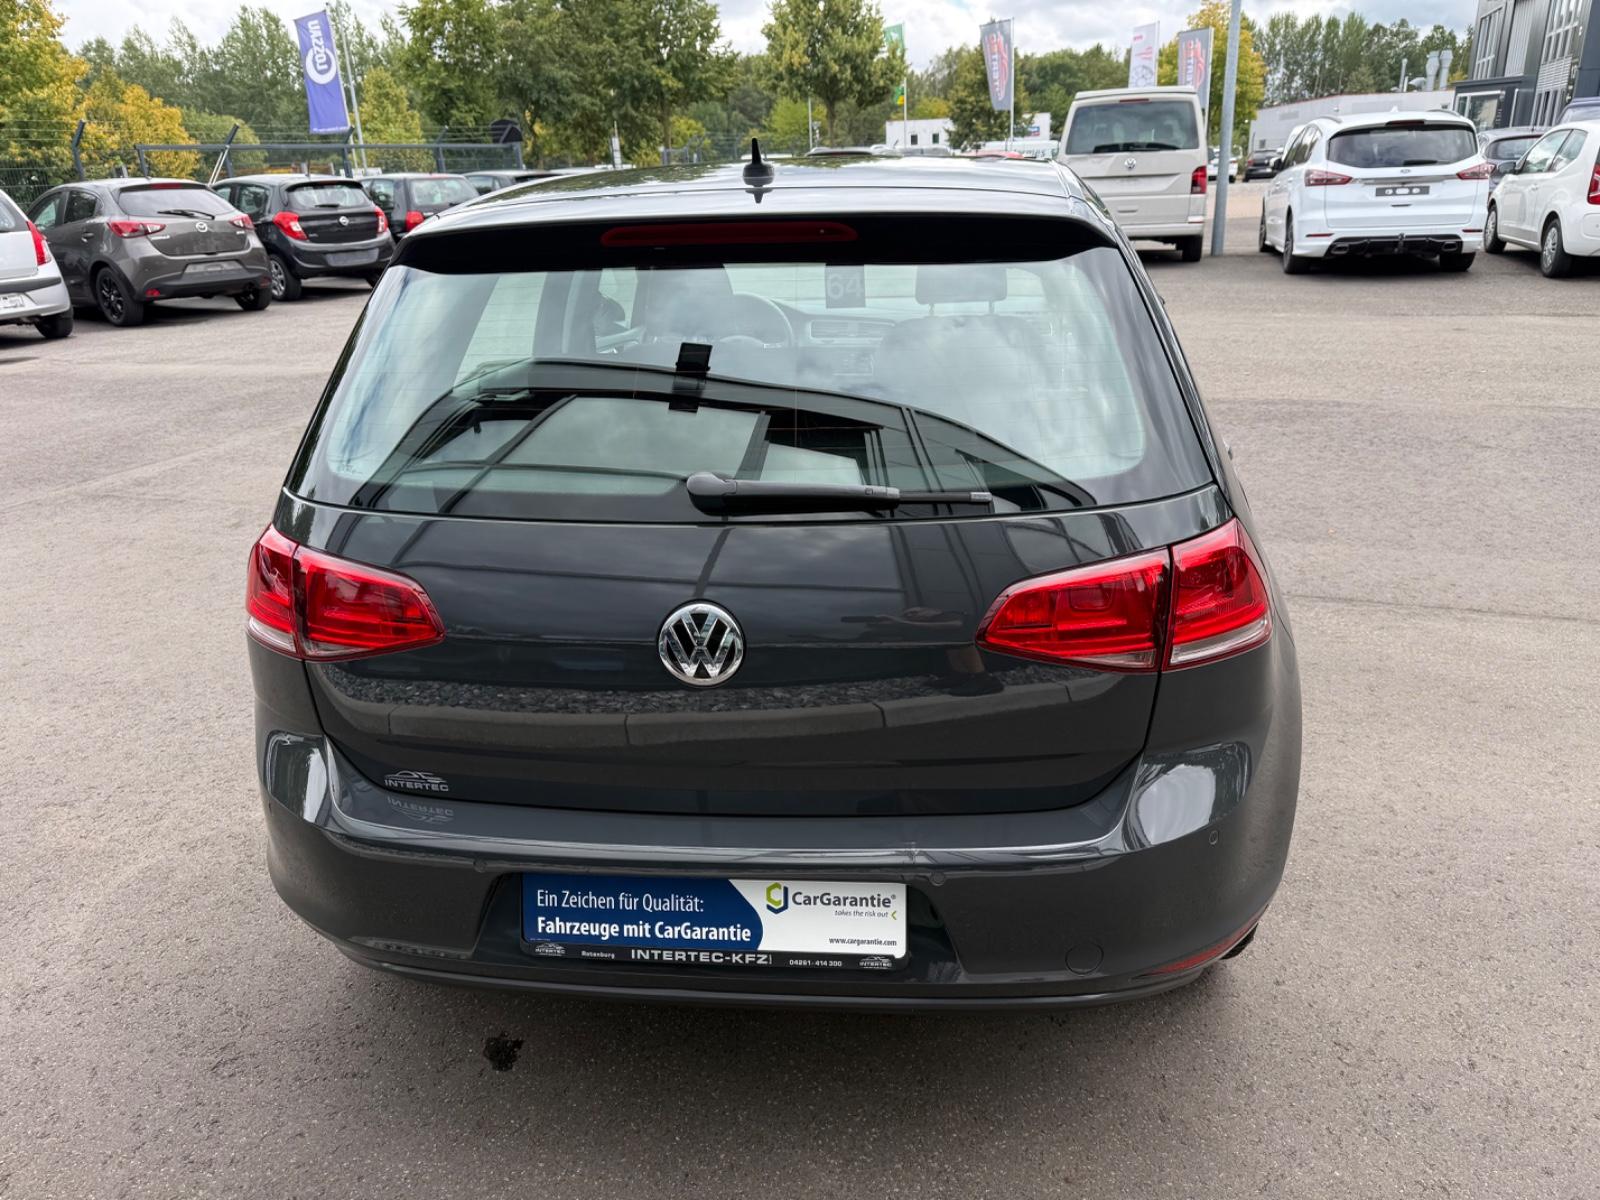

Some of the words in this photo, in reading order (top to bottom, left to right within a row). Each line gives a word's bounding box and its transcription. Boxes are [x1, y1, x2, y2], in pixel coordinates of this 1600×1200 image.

[827, 272, 864, 300] 64
[384, 779, 449, 792] INTERTEC
[537, 889, 558, 908] Ein
[561, 890, 615, 910] Zeichen
[619, 892, 639, 910] für
[642, 893, 704, 912] Qualität:
[834, 909, 852, 917] takes
[853, 909, 864, 917] the
[865, 910, 876, 918] risk
[537, 916, 620, 941] Fahrzeuge
[623, 920, 651, 939] mit
[654, 921, 752, 942] CarGarantie
[828, 937, 897, 947] www.cargarantie.com
